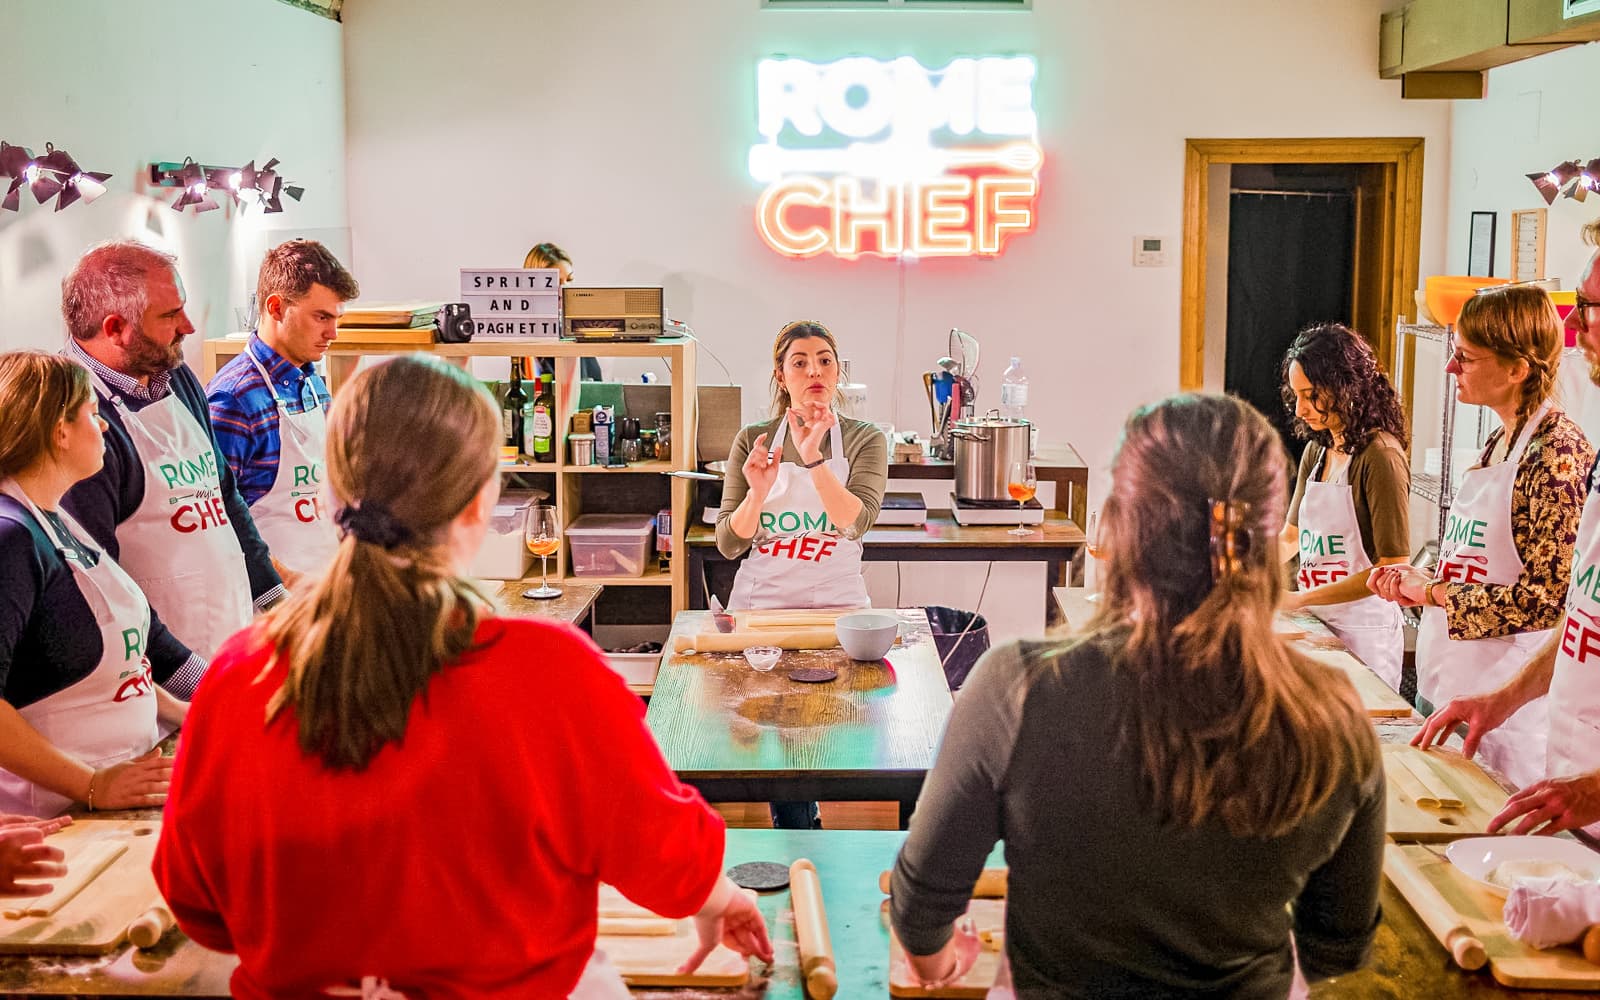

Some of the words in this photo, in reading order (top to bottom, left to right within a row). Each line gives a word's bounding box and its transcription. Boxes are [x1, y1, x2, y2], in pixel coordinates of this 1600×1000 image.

[757, 56, 1036, 136] ROME
[757, 176, 1036, 256] CHEF
[474, 276, 553, 288] SPRITZ
[490, 299, 530, 311] AND
[477, 322, 557, 335] PAGHETTI
[160, 451, 217, 489] ROME
[170, 497, 228, 533] CHE
[760, 511, 837, 533] ROM
[1300, 529, 1346, 556] OME
[1562, 616, 1600, 663] EF
